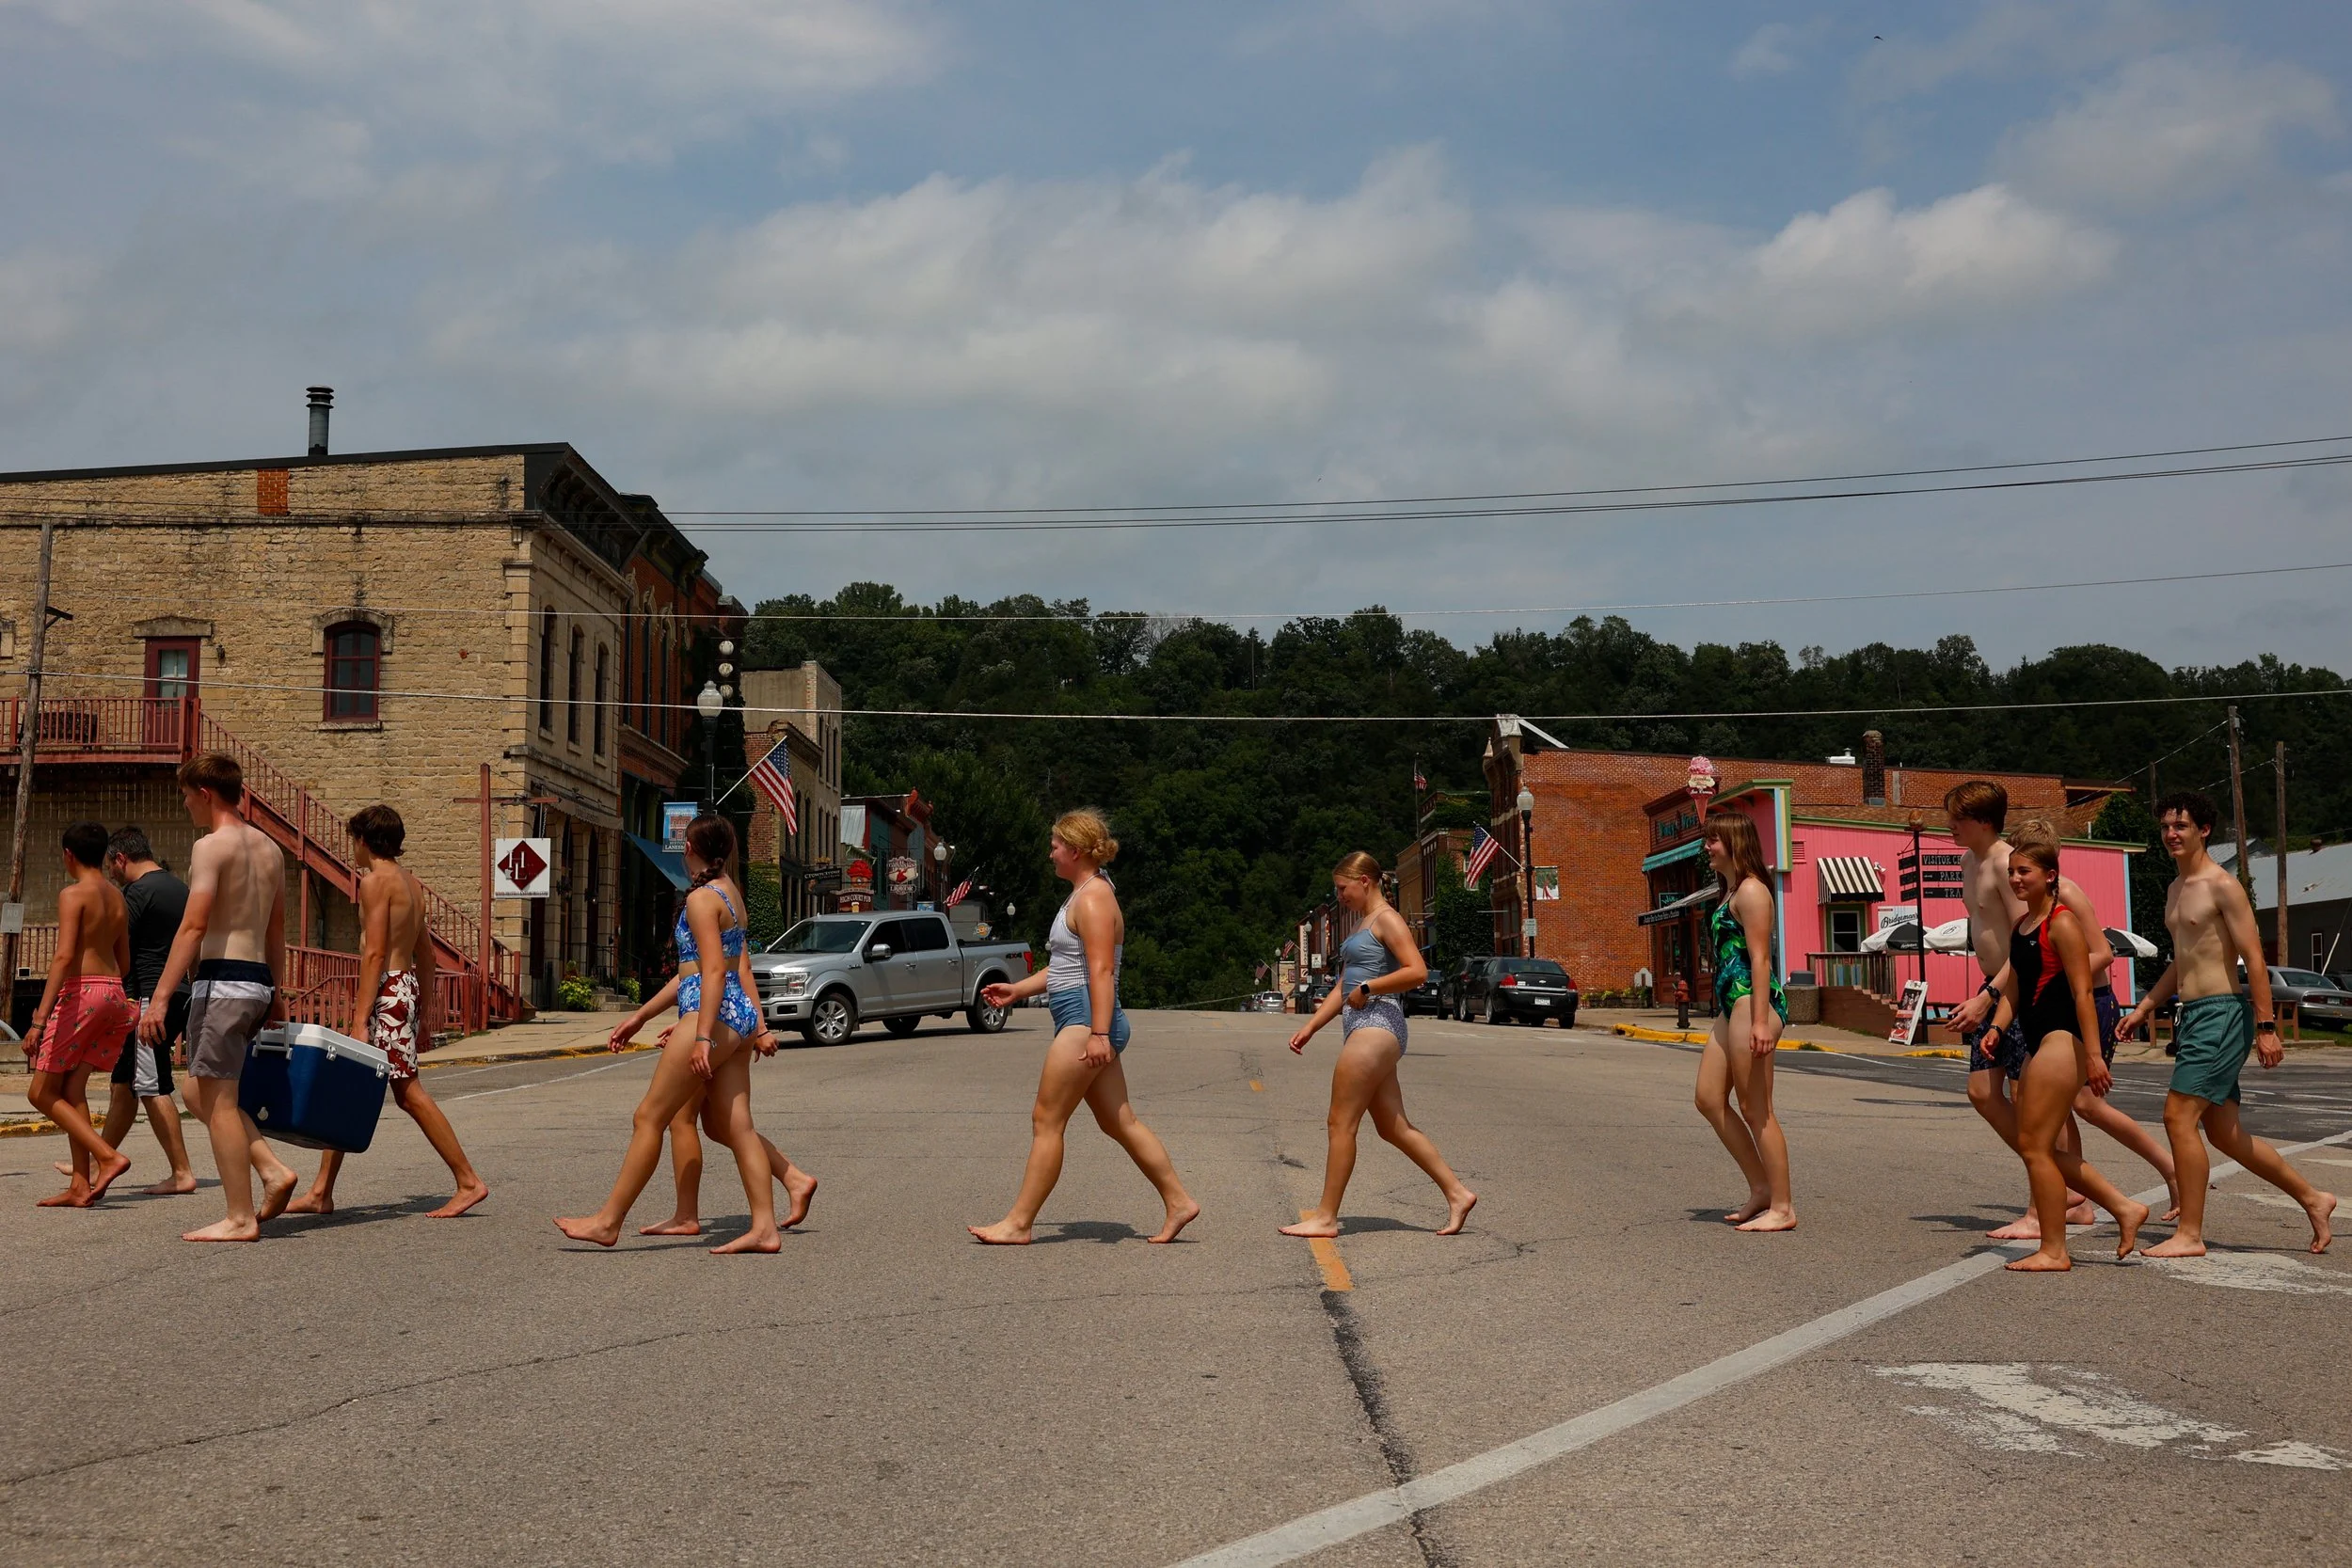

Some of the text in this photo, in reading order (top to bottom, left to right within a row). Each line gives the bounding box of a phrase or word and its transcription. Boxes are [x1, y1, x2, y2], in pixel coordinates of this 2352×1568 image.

[1923, 855, 1951, 865] VISITOR
[1939, 871, 1964, 881] PARKI
[1944, 888, 1962, 897] TRA
[863, 895, 871, 903] PUB
